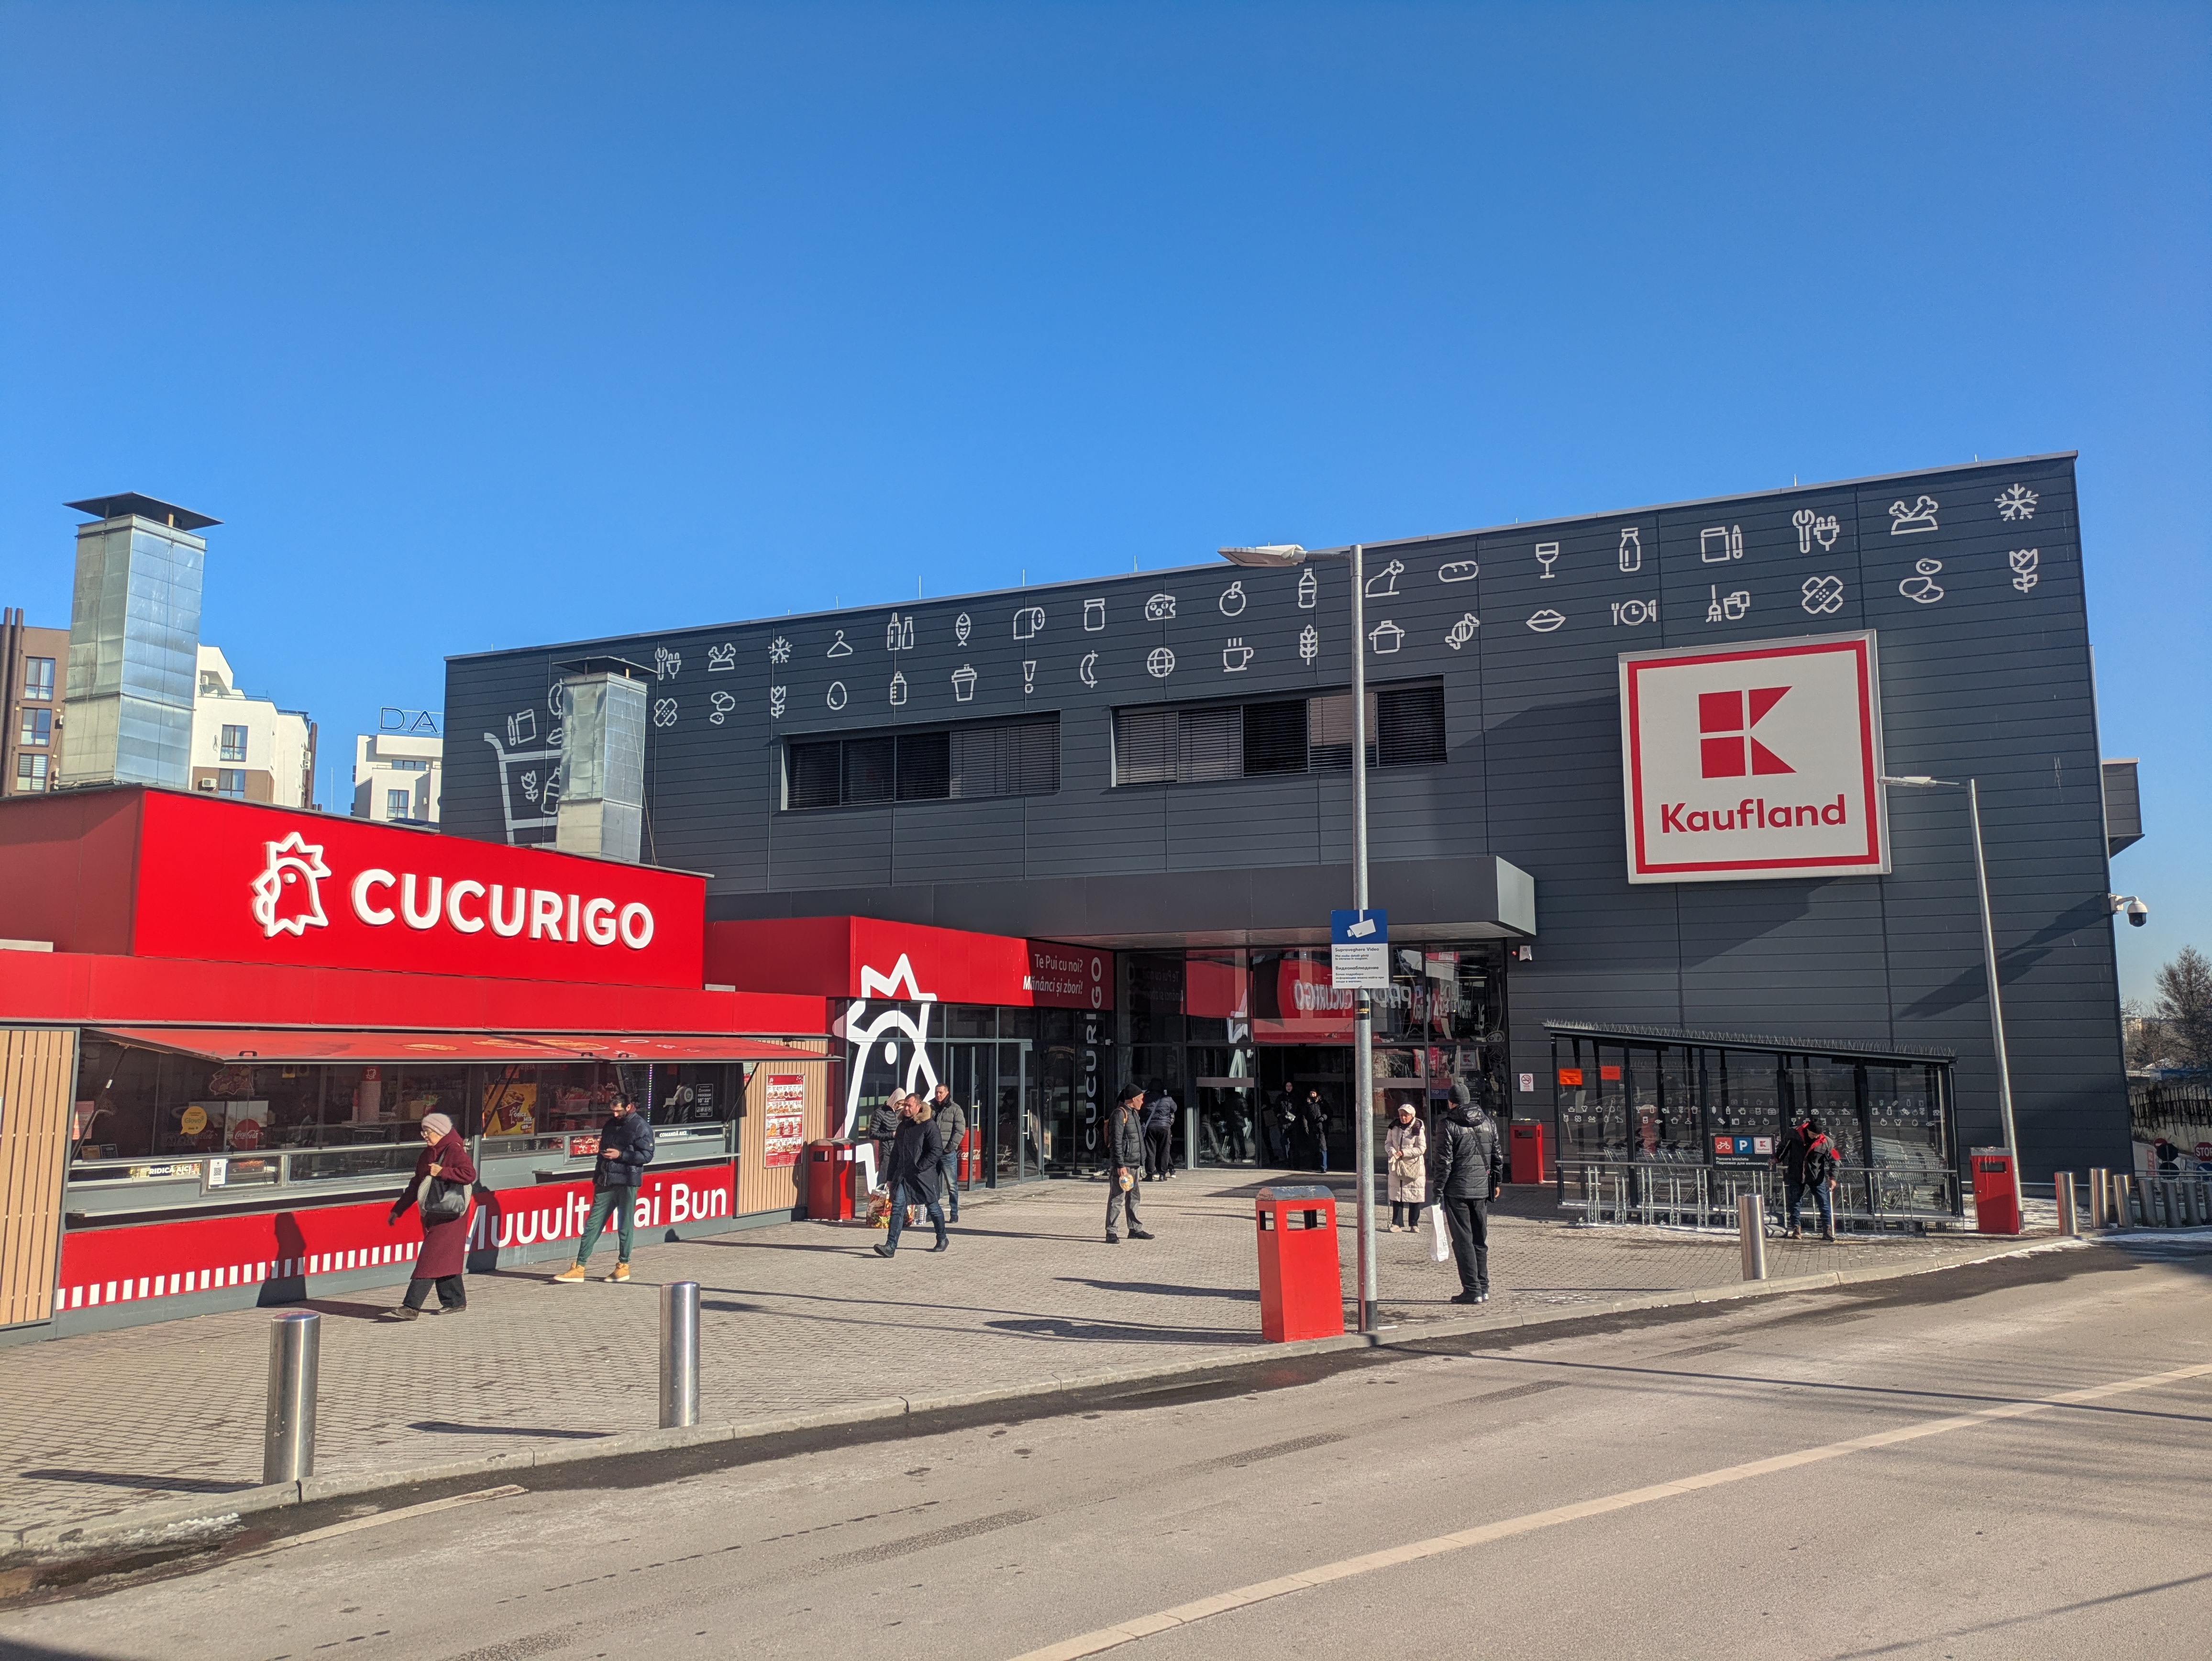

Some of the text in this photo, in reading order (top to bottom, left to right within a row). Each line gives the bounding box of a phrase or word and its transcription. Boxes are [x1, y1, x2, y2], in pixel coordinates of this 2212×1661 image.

[379, 706, 440, 734] DA
[1661, 794, 1846, 833] Kaufland
[351, 869, 654, 949] CUCURIGO
[1035, 954, 1083, 973] Te Pui cu noi?
[1023, 975, 1083, 997] Mănânci și zbori!
[1086, 957, 1102, 1150] CUCURIGO
[1739, 1140, 1747, 1151] P
[670, 1183, 727, 1224] Bun
